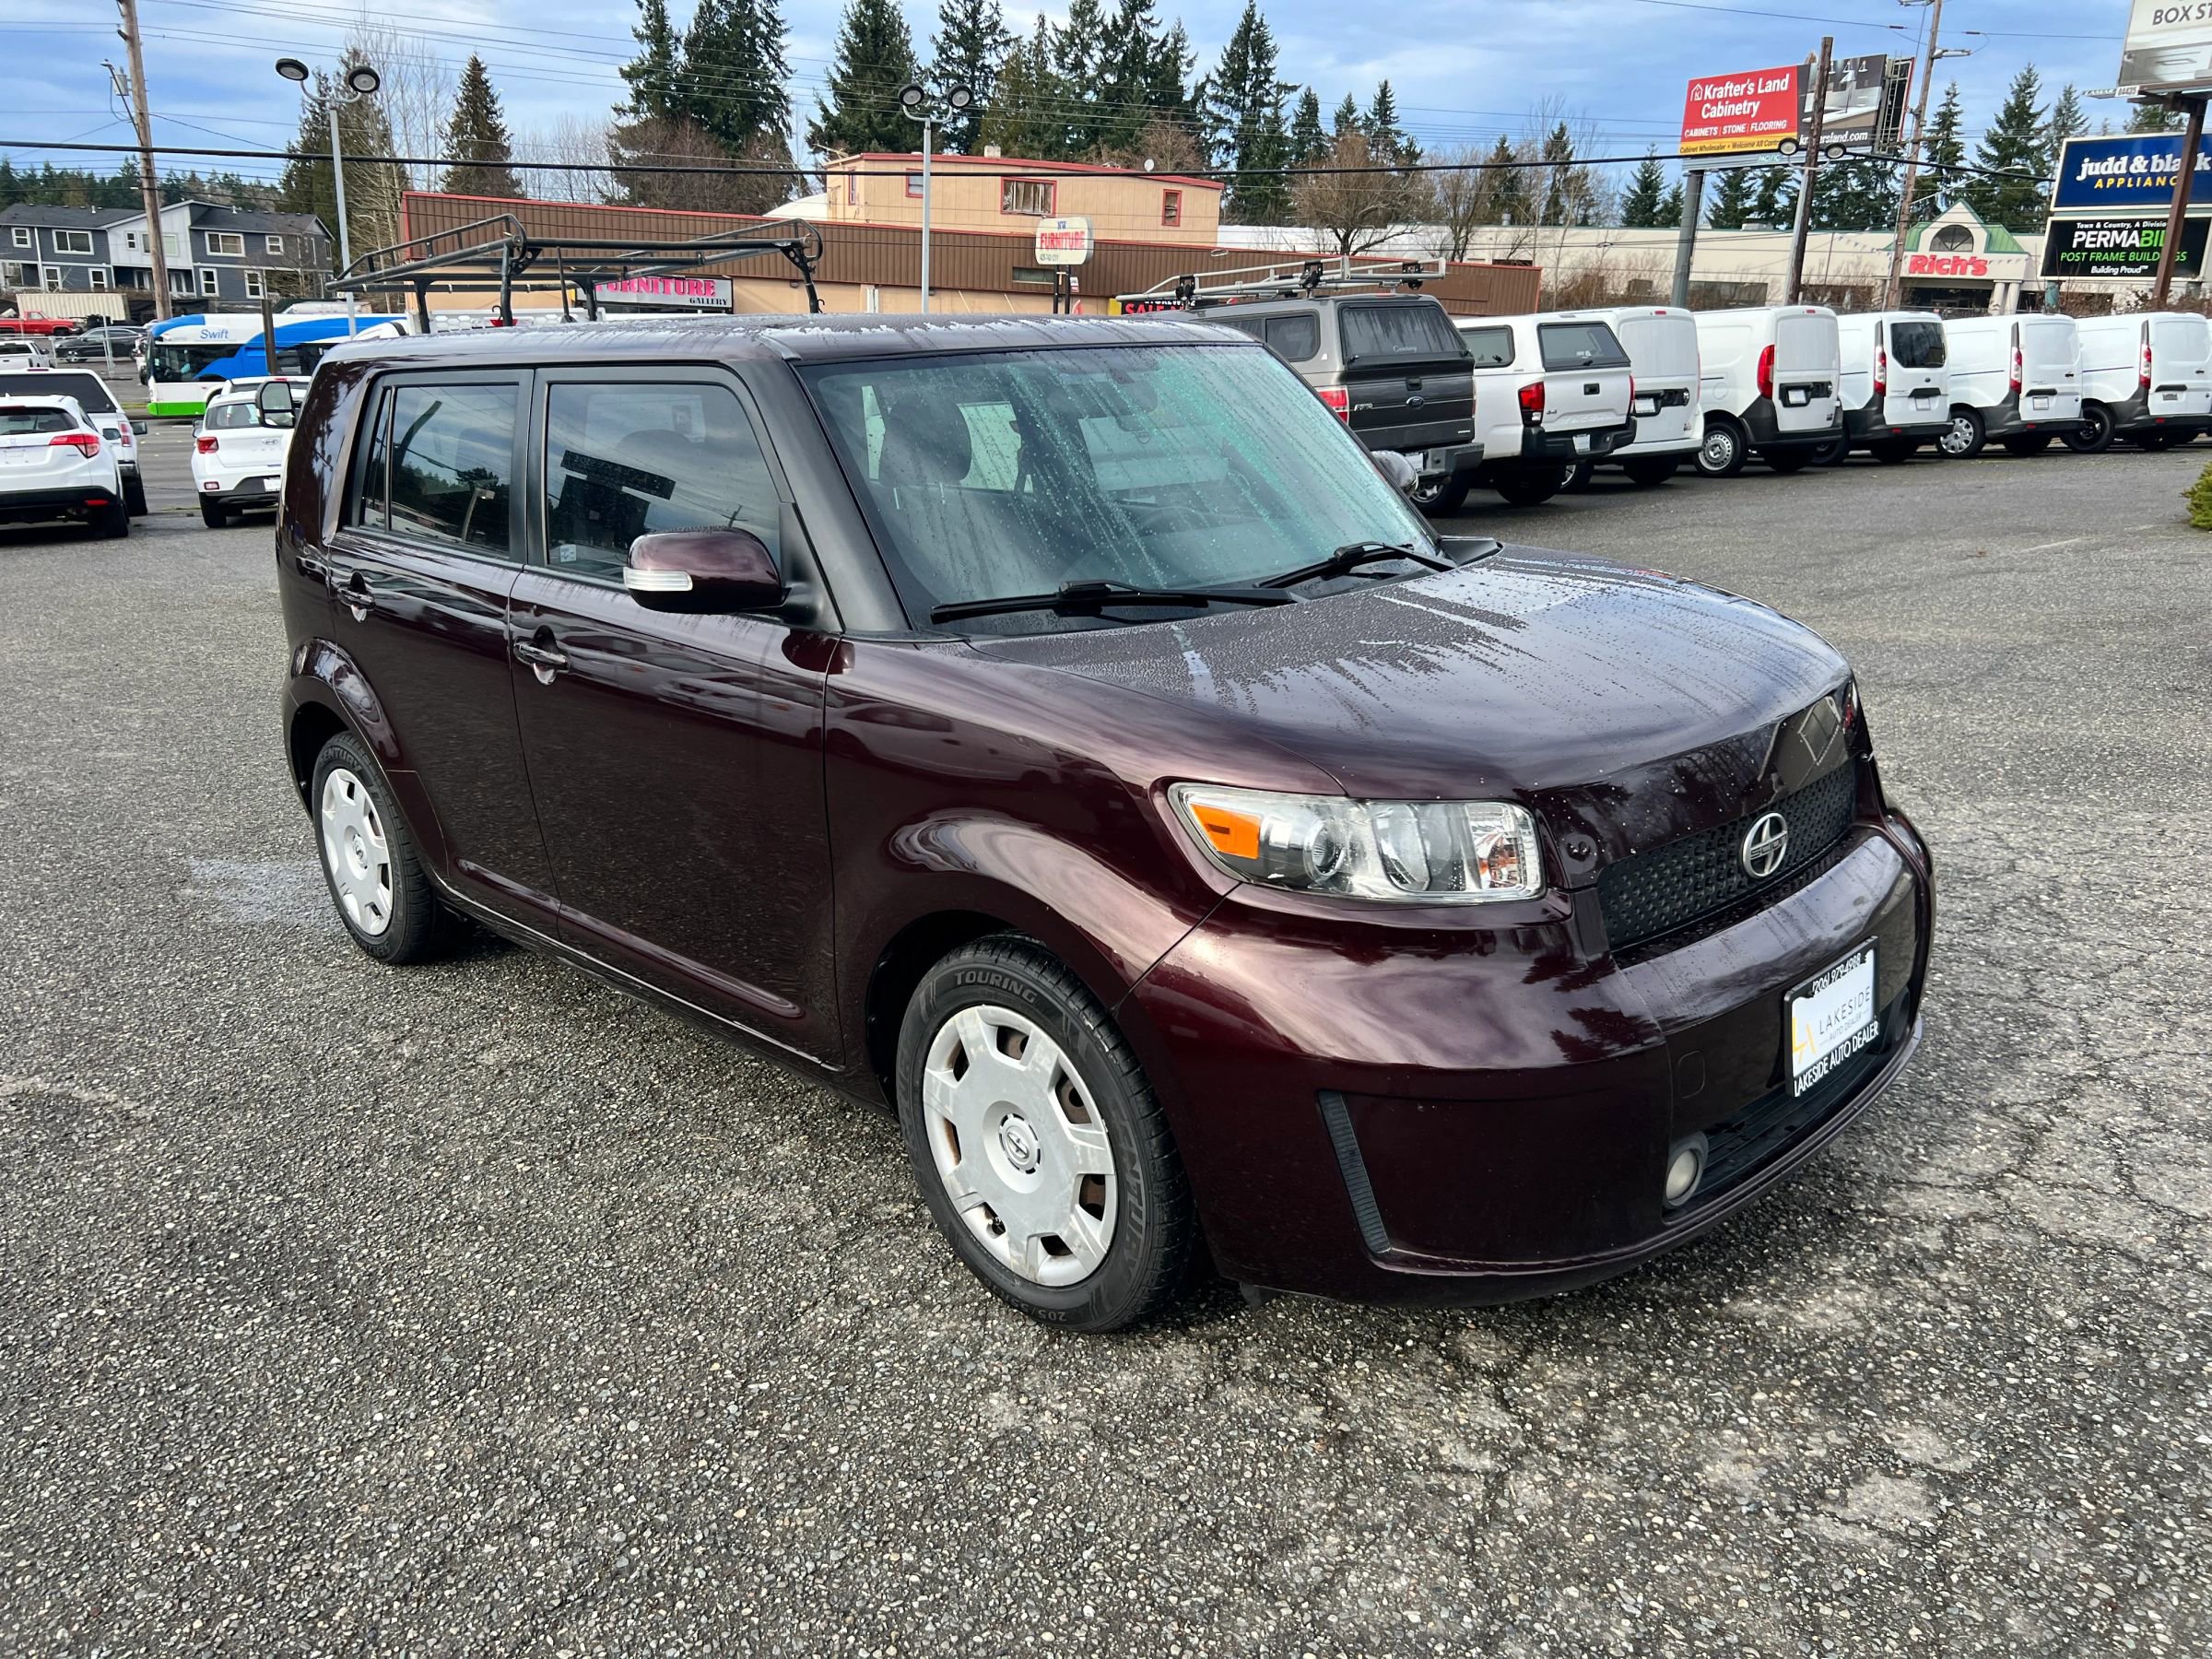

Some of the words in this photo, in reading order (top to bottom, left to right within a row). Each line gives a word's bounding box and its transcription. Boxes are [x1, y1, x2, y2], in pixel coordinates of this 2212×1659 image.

[2152, 5, 2194, 26] BOX
[1703, 78, 1755, 100] Krafter's
[1758, 73, 1790, 95] Land
[1701, 100, 1760, 119] Cabinetry
[1684, 126, 1718, 138] CABINETS
[1722, 123, 1747, 135] STONE
[1750, 120, 1787, 132] FLOORING
[2076, 156, 2129, 182] judd
[2130, 155, 2149, 174] &
[2150, 151, 2212, 173] blak
[2094, 175, 2179, 190] APPLIANC
[1040, 230, 1086, 251] FURNITURE
[1908, 253, 1988, 276] Rich's
[2060, 252, 2088, 262] POST
[2089, 252, 2125, 262] FRAME
[2128, 251, 2188, 262] BUILDGS
[2090, 265, 2120, 276] Building
[689, 297, 727, 306] GALLERY
[200, 328, 229, 339] Swift
[954, 970, 1039, 1006] TOURING
[1819, 986, 1871, 1035] LAKESIDE
[1794, 1056, 1829, 1098] LAKESIDE
[1830, 1041, 1851, 1070] AUTO
[1852, 1020, 1879, 1053] DEALER
